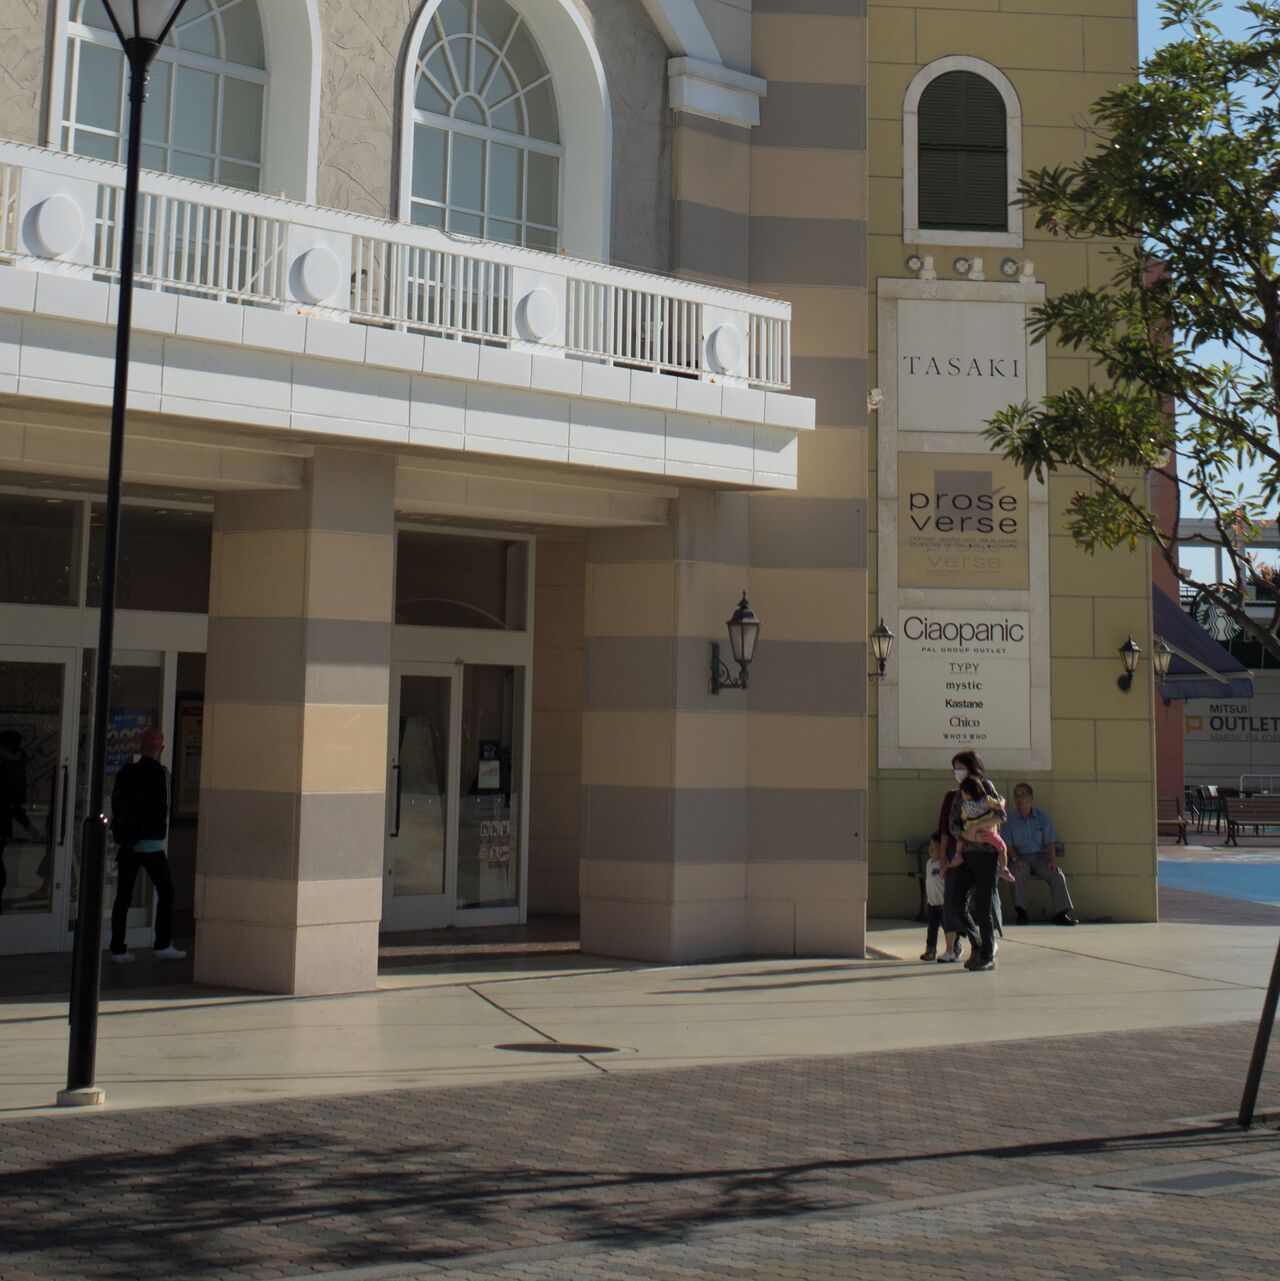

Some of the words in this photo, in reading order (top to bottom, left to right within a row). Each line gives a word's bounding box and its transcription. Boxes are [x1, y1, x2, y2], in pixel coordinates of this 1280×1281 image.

[903, 356, 1020, 377] TASAKI
[910, 515, 1017, 534] verse
[903, 616, 1024, 646] Ciaopanic
[949, 662, 980, 672] TYPY
[945, 680, 983, 692] mystic
[945, 698, 984, 709] Kastane
[1209, 703, 1248, 714] MITSUI
[949, 716, 981, 728] Chico
[1209, 716, 1280, 732] OUTLET
